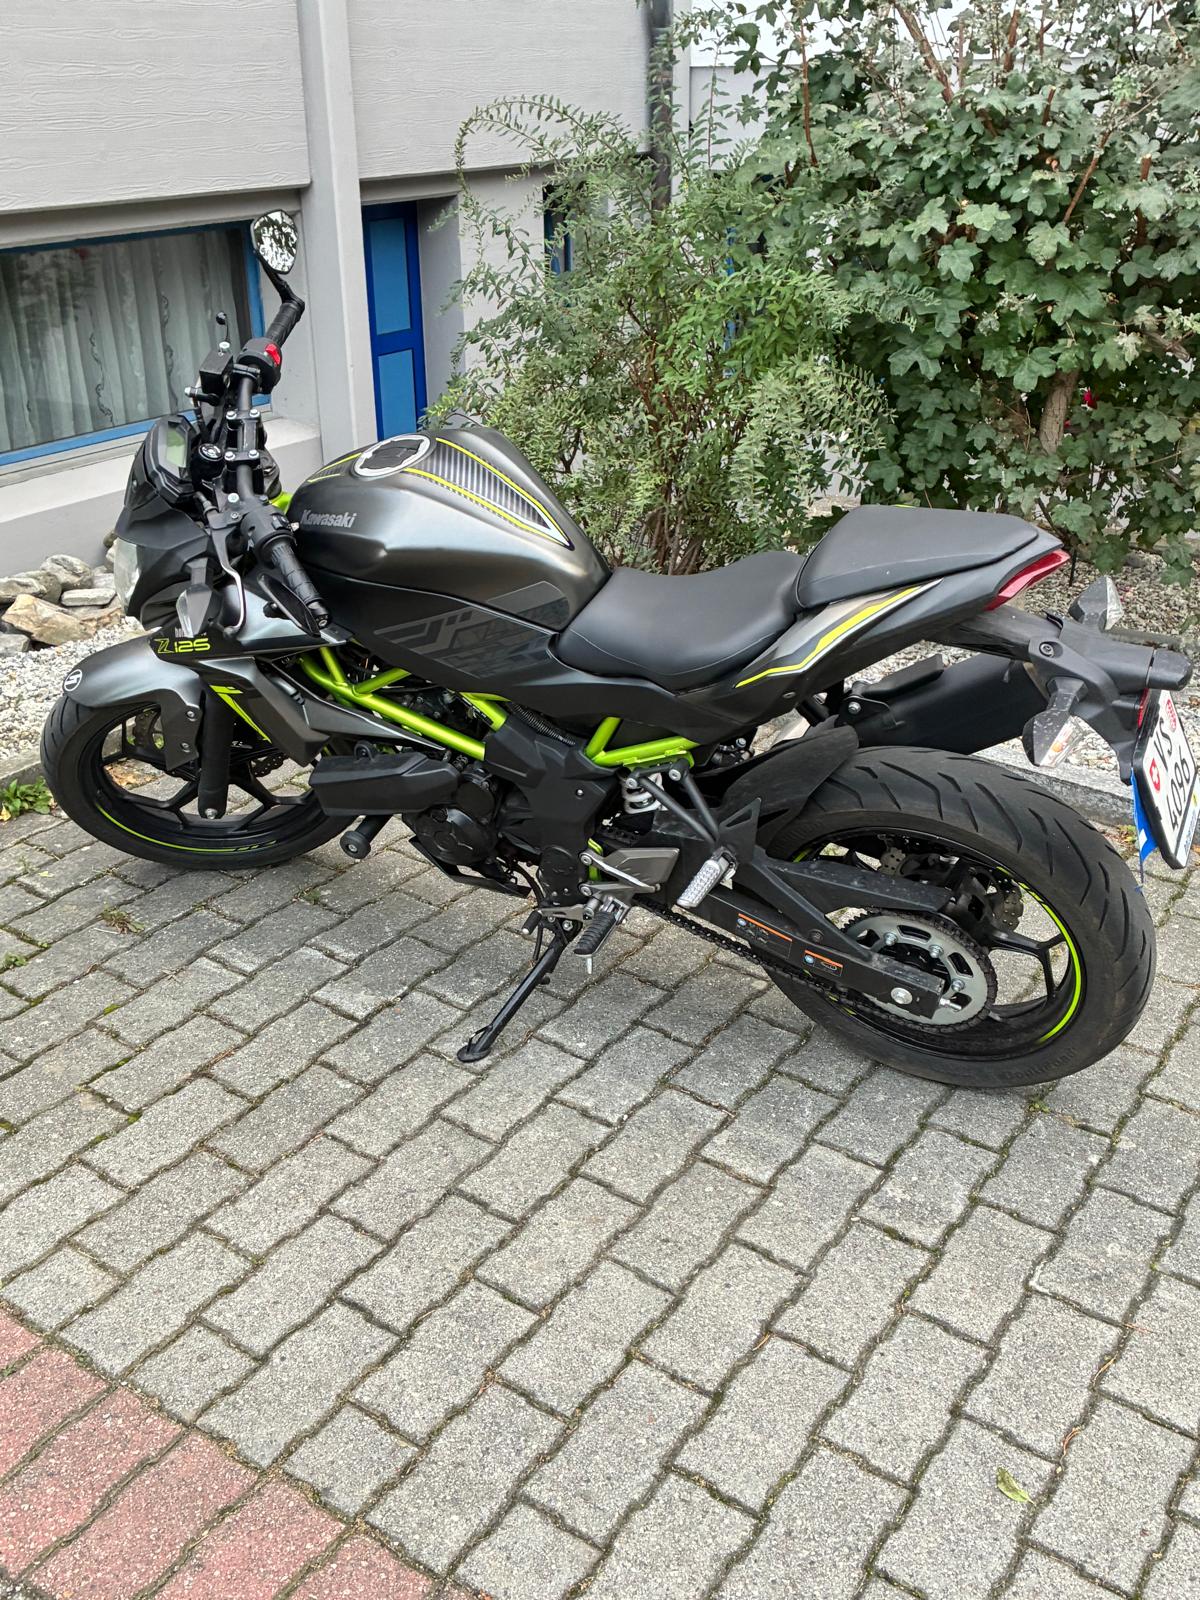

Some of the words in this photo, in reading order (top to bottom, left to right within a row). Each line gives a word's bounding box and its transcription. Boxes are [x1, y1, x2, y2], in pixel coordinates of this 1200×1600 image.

[300, 509, 357, 528] Kawasaki
[1153, 716, 1173, 773] VS
[1166, 745, 1191, 832] 4096
